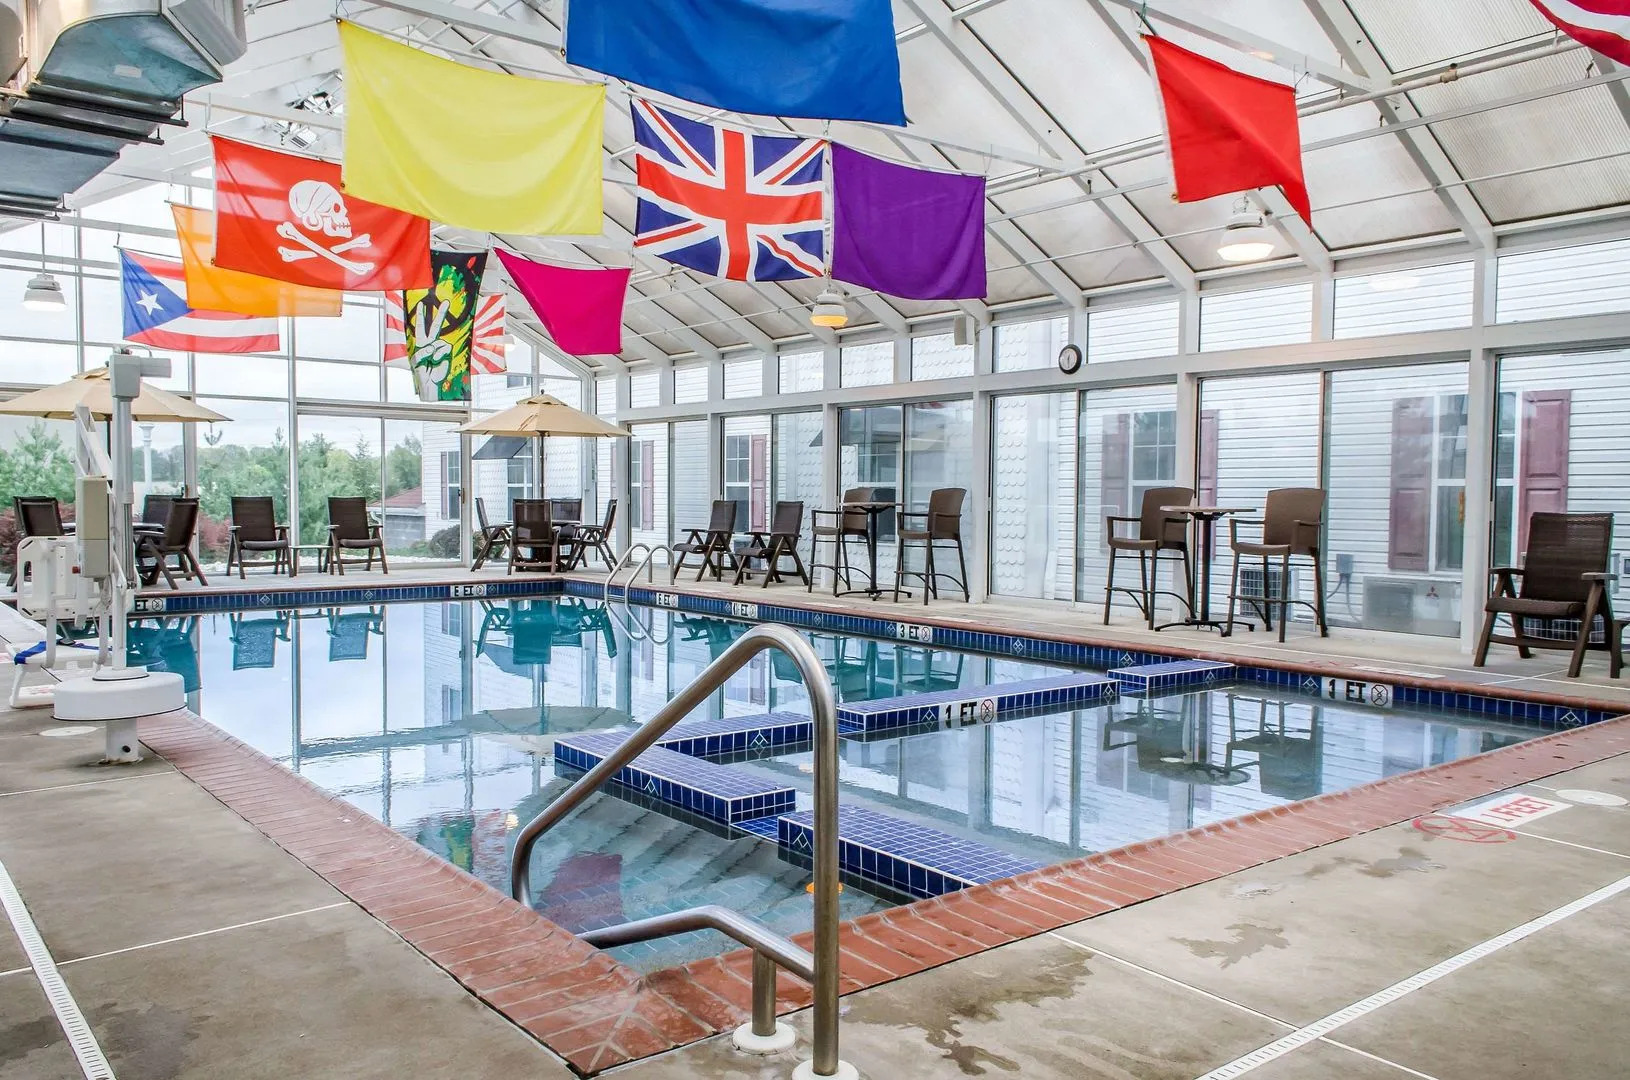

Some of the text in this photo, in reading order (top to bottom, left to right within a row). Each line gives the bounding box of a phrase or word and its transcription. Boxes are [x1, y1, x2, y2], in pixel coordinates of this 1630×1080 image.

[944, 701, 978, 720] 1 FT
[1489, 797, 1554, 818] FEET
